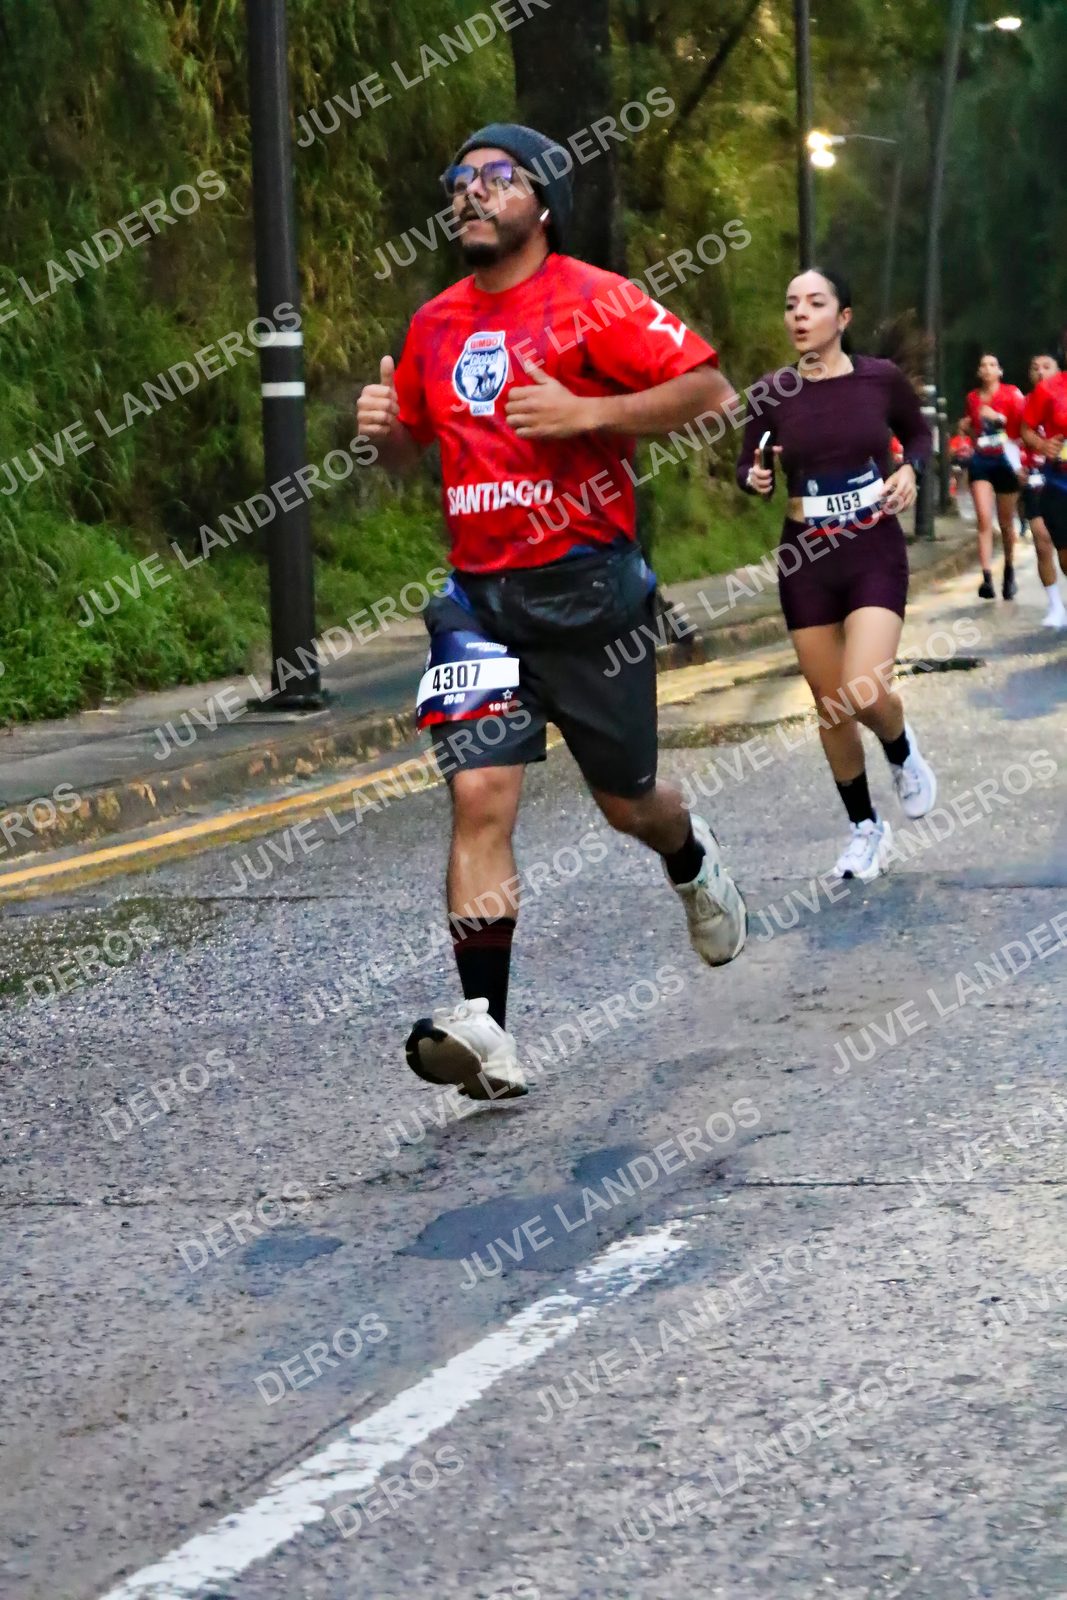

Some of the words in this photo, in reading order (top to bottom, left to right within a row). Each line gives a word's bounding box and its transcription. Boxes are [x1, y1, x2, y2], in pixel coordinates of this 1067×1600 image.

[447, 480, 554, 516] SANTIAGO
[826, 492, 861, 512] 4153
[432, 664, 481, 691] 4307
